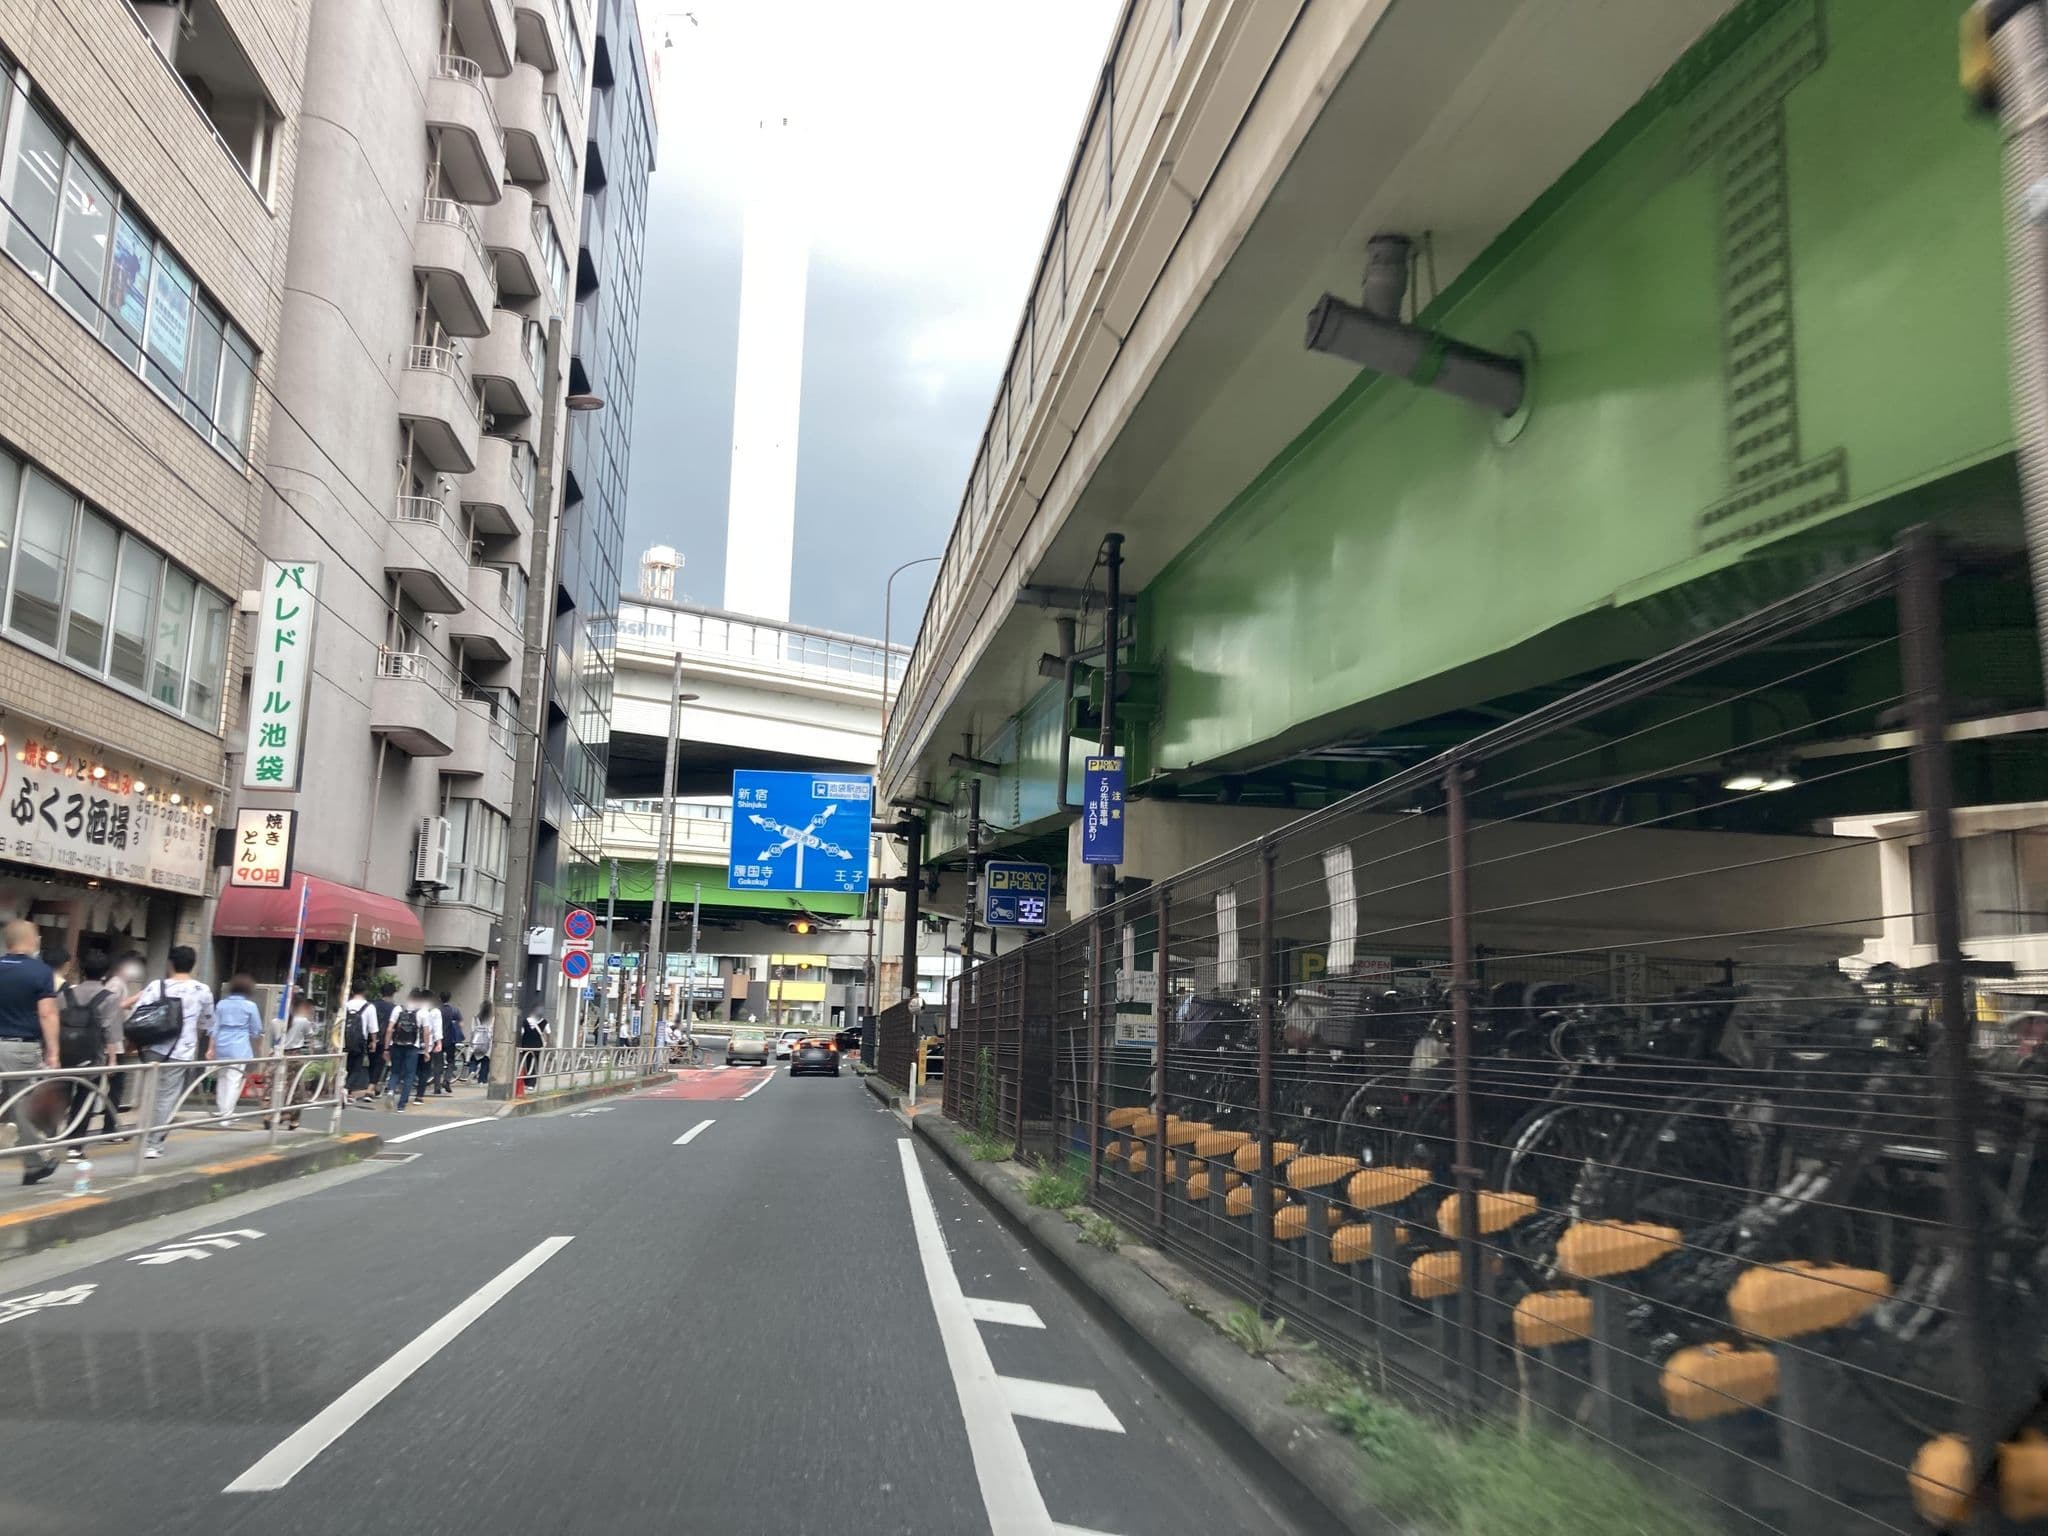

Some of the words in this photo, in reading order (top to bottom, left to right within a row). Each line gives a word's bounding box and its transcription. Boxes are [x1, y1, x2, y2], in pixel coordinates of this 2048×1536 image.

[256, 566, 305, 782] パレドール池袋
[737, 788, 768, 801] 新宿
[1100, 777, 1109, 827] この先駐車場
[11, 776, 130, 850] ぶくろ酒場
[737, 801, 768, 809] Shinjuku
[1088, 800, 1098, 842] 出入口あり
[265, 813, 283, 846] 焼き
[240, 830, 259, 863] とん
[237, 867, 281, 883] 90円
[734, 864, 774, 878] 護国寺
[834, 870, 863, 882] 王子
[1009, 871, 1047, 881] TOKYO
[843, 883, 855, 892] Oji
[992, 871, 1006, 888] P
[1009, 880, 1046, 891] PUBLIC
[991, 898, 999, 909] P
[1018, 897, 1044, 923] 空
[1302, 952, 1326, 982] P
